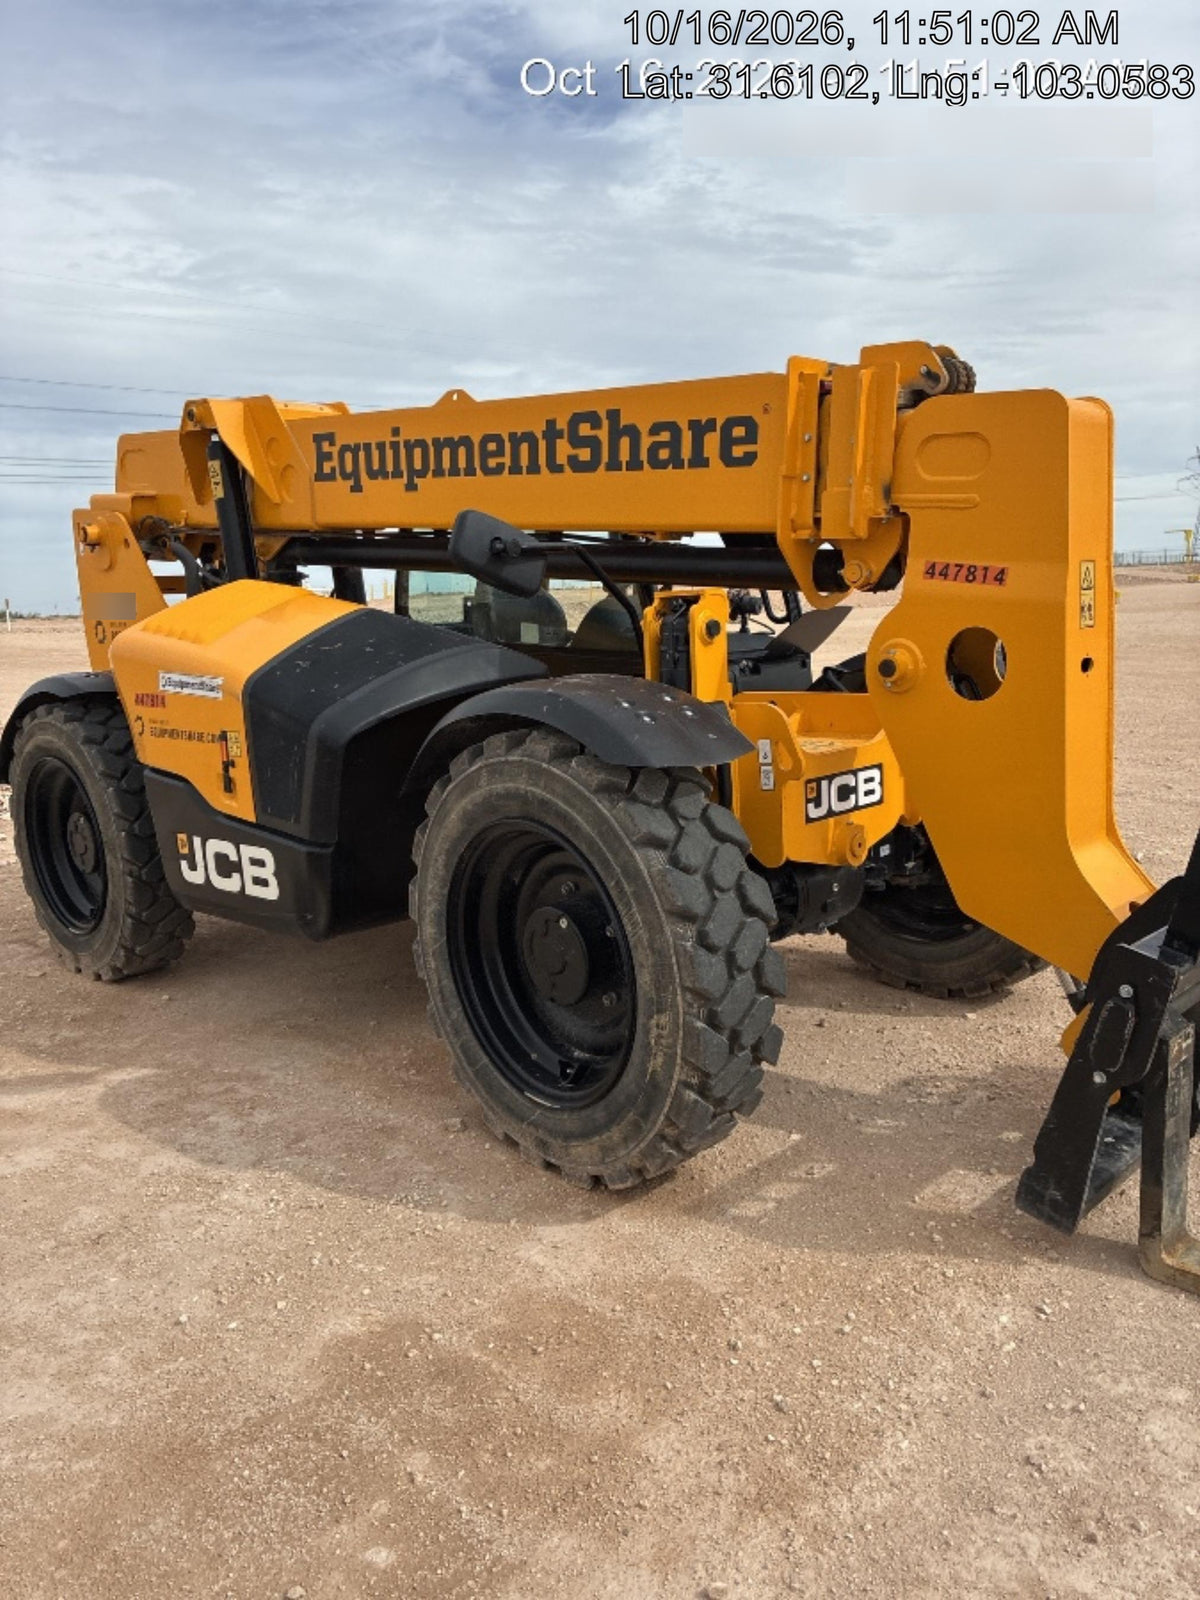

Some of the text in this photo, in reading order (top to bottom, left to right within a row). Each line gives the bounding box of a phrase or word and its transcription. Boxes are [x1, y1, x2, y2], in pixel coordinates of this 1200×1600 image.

[312, 408, 760, 493] EquipmentShare
[924, 560, 1006, 586] 447814
[806, 767, 883, 819] JCB
[179, 834, 280, 901] JCB
